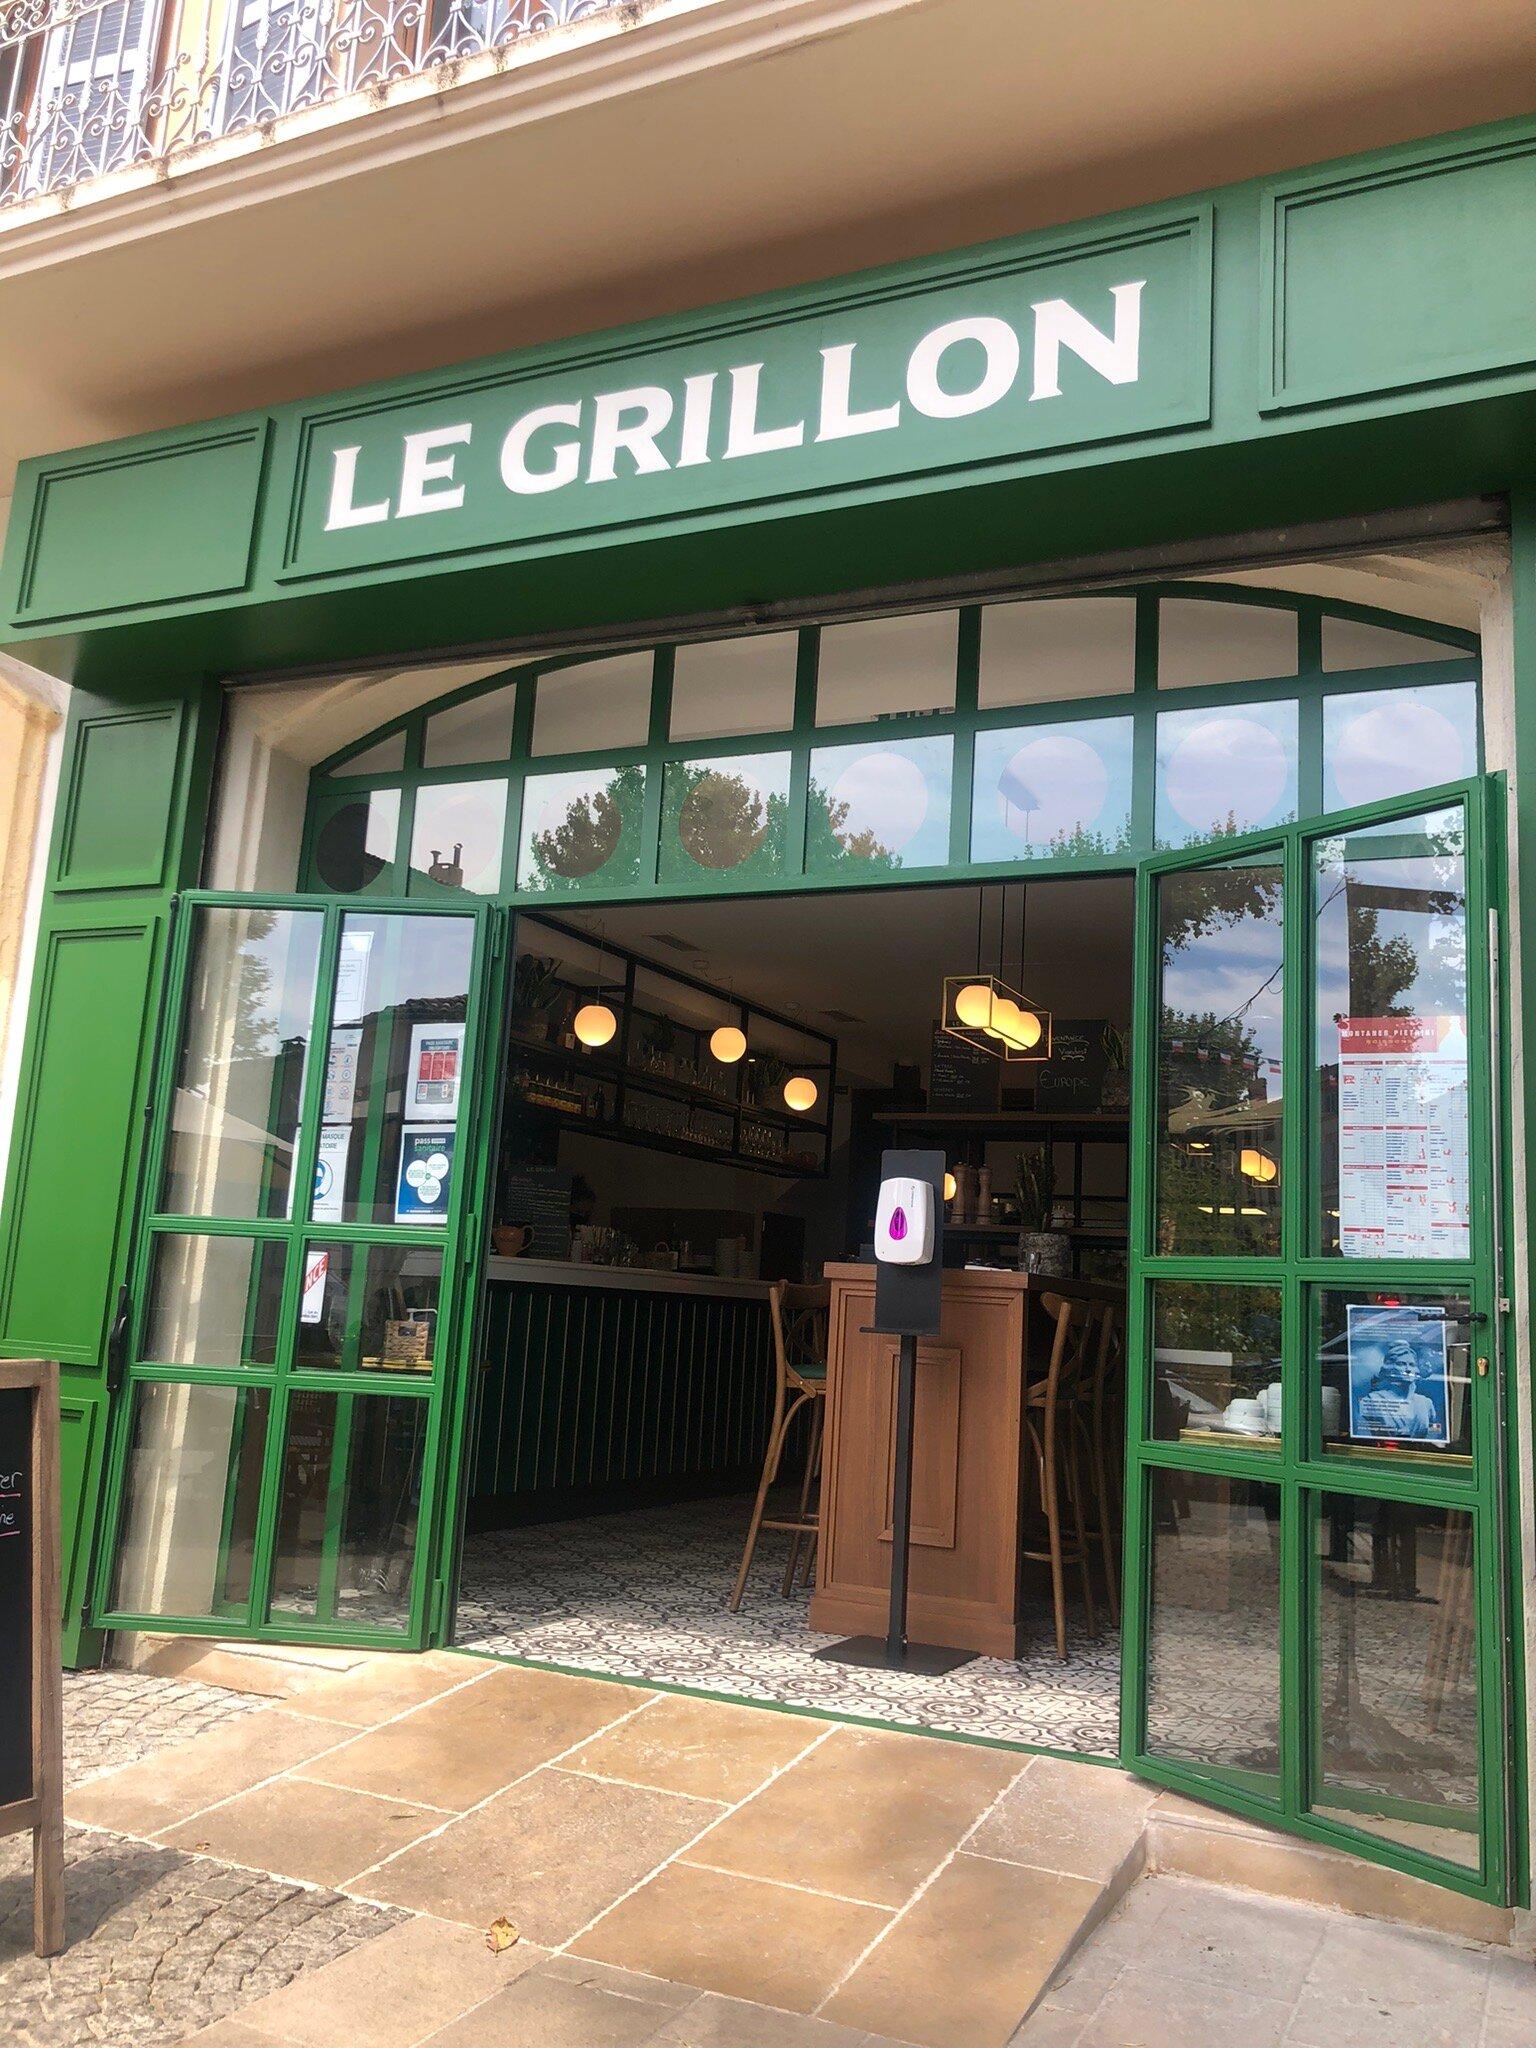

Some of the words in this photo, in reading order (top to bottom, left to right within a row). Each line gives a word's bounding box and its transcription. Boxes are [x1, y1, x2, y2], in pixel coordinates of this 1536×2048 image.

[324, 422, 473, 532] LE
[499, 279, 1147, 497] GRILLON
[1341, 1029, 1389, 1038] MONTANER
[322, 1132, 345, 1140] MASQUE
[414, 1137, 430, 1146] pass
